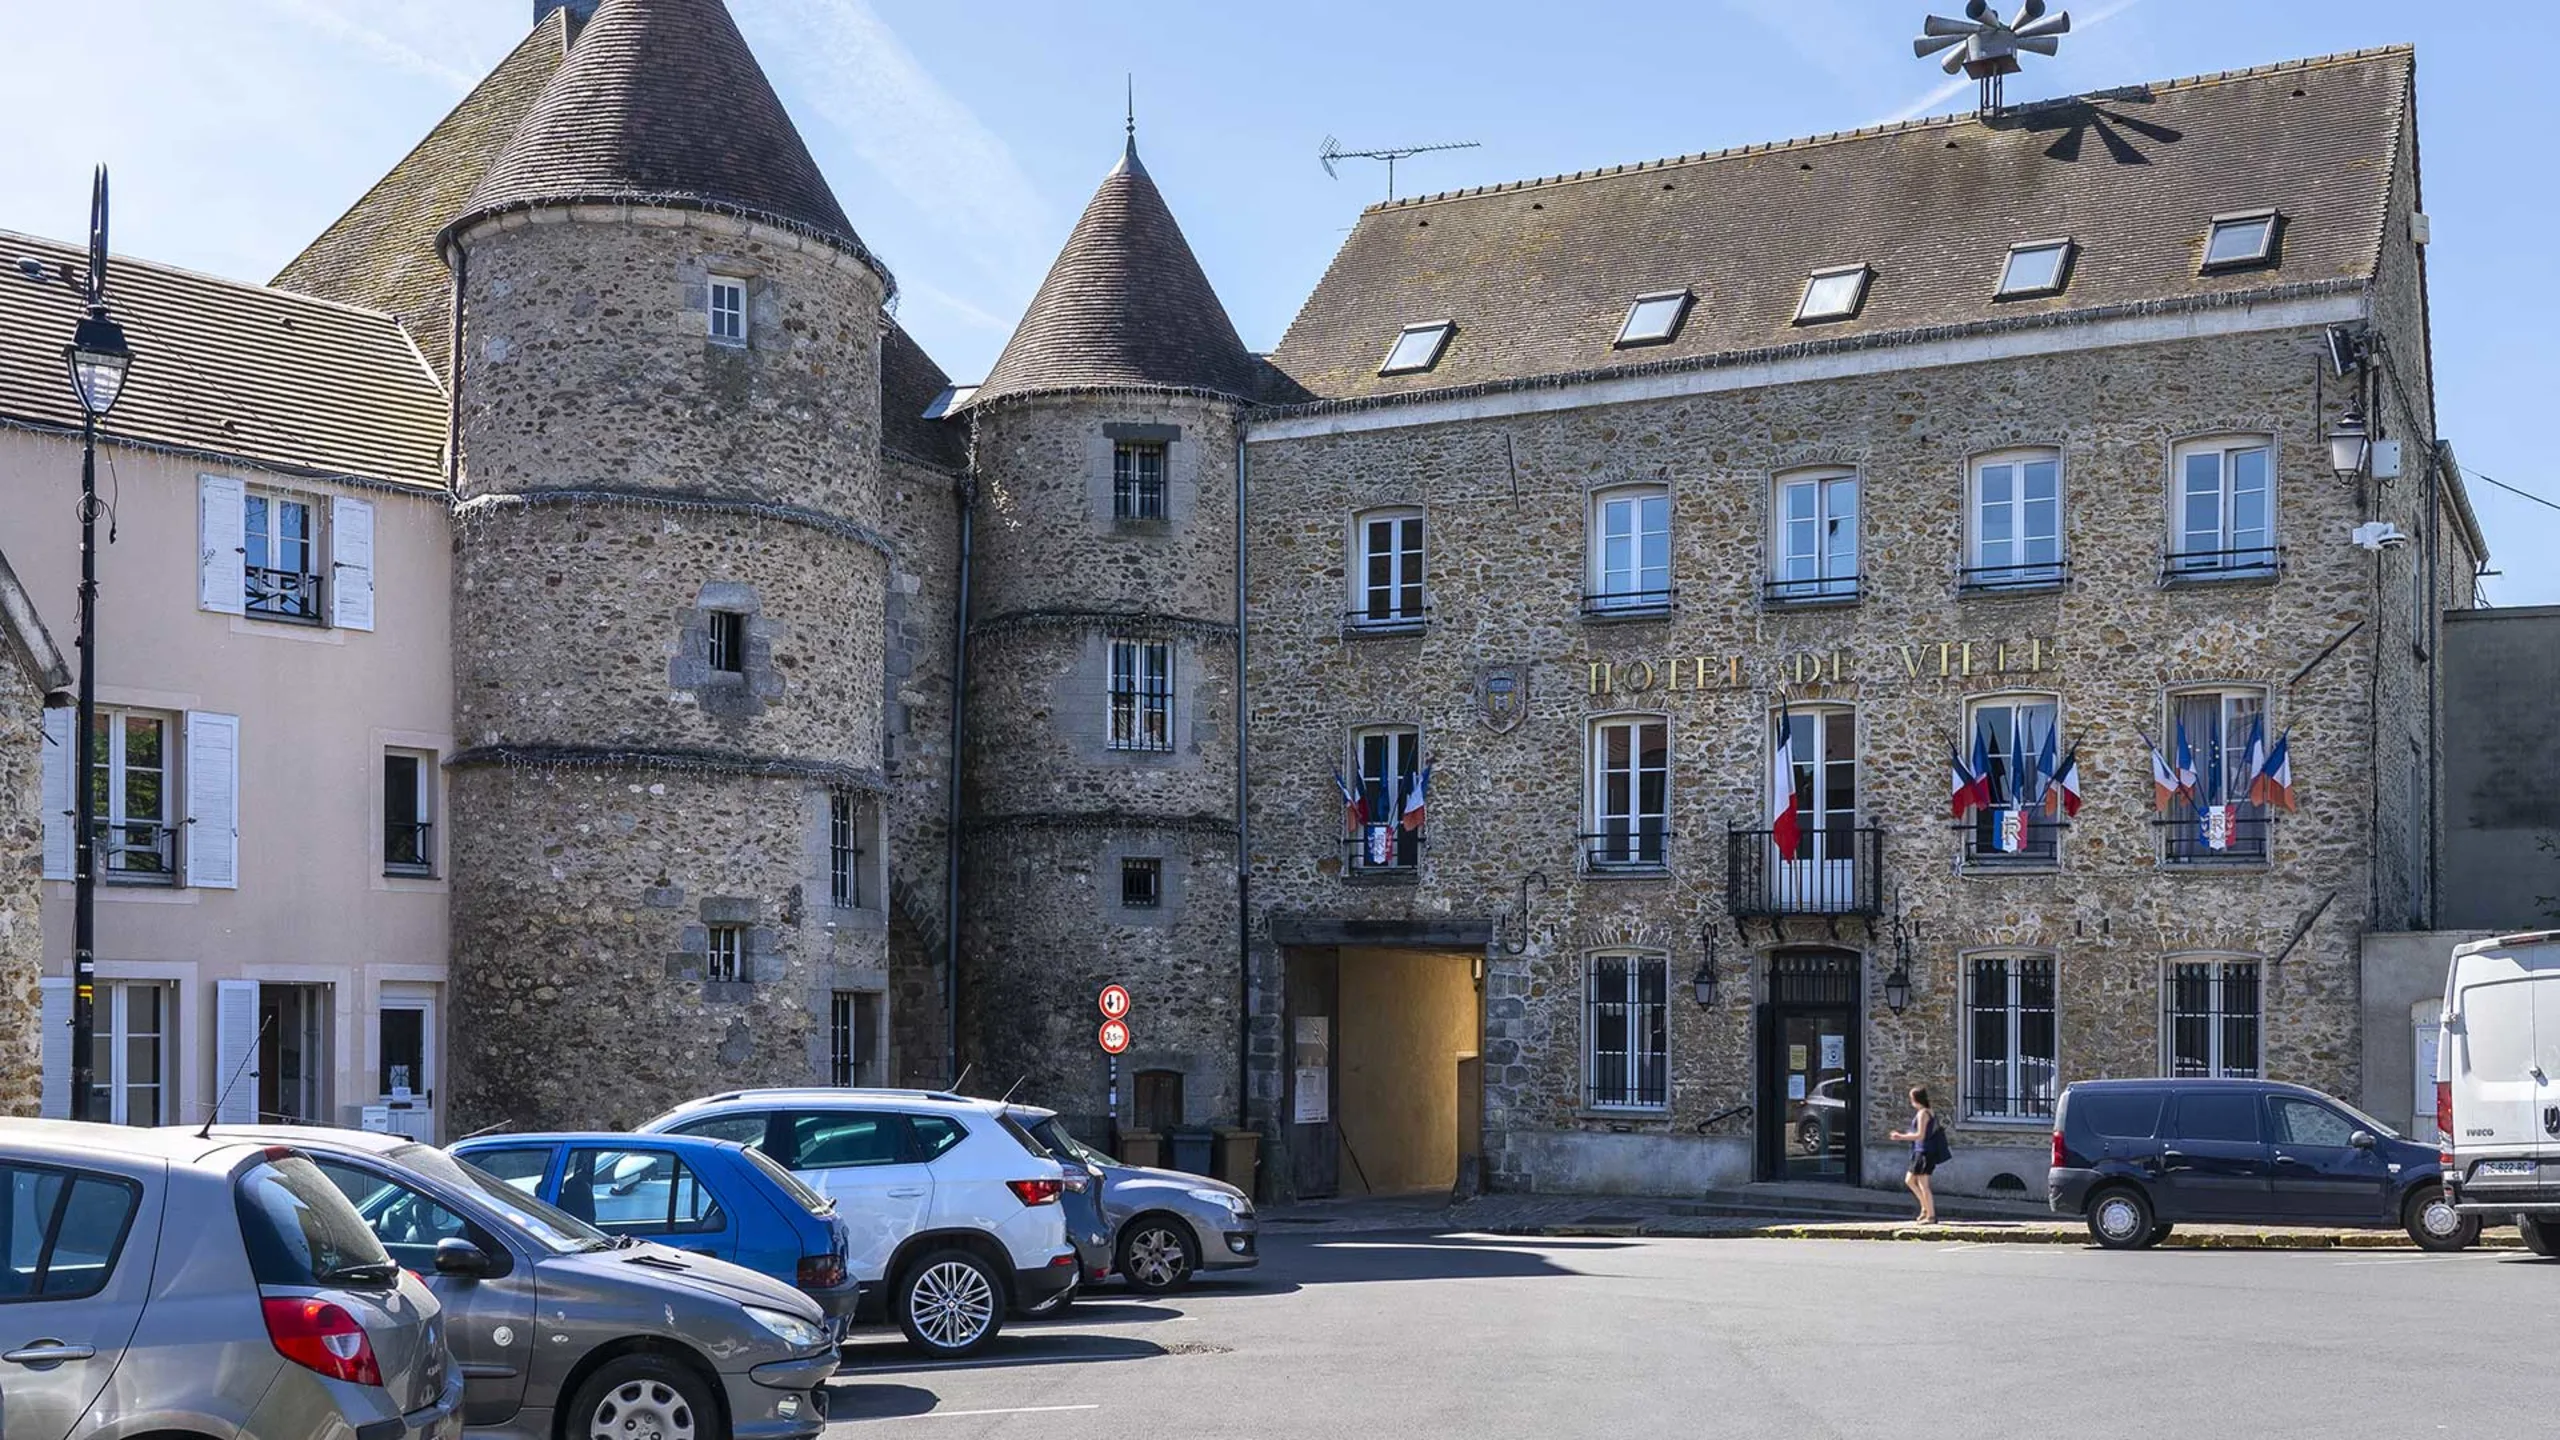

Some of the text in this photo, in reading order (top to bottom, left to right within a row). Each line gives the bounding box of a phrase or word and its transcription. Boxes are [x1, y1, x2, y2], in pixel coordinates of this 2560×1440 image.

[1588, 638, 2061, 696] HOTEL DE VILLE
[2466, 1128, 2495, 1137] IVECO
